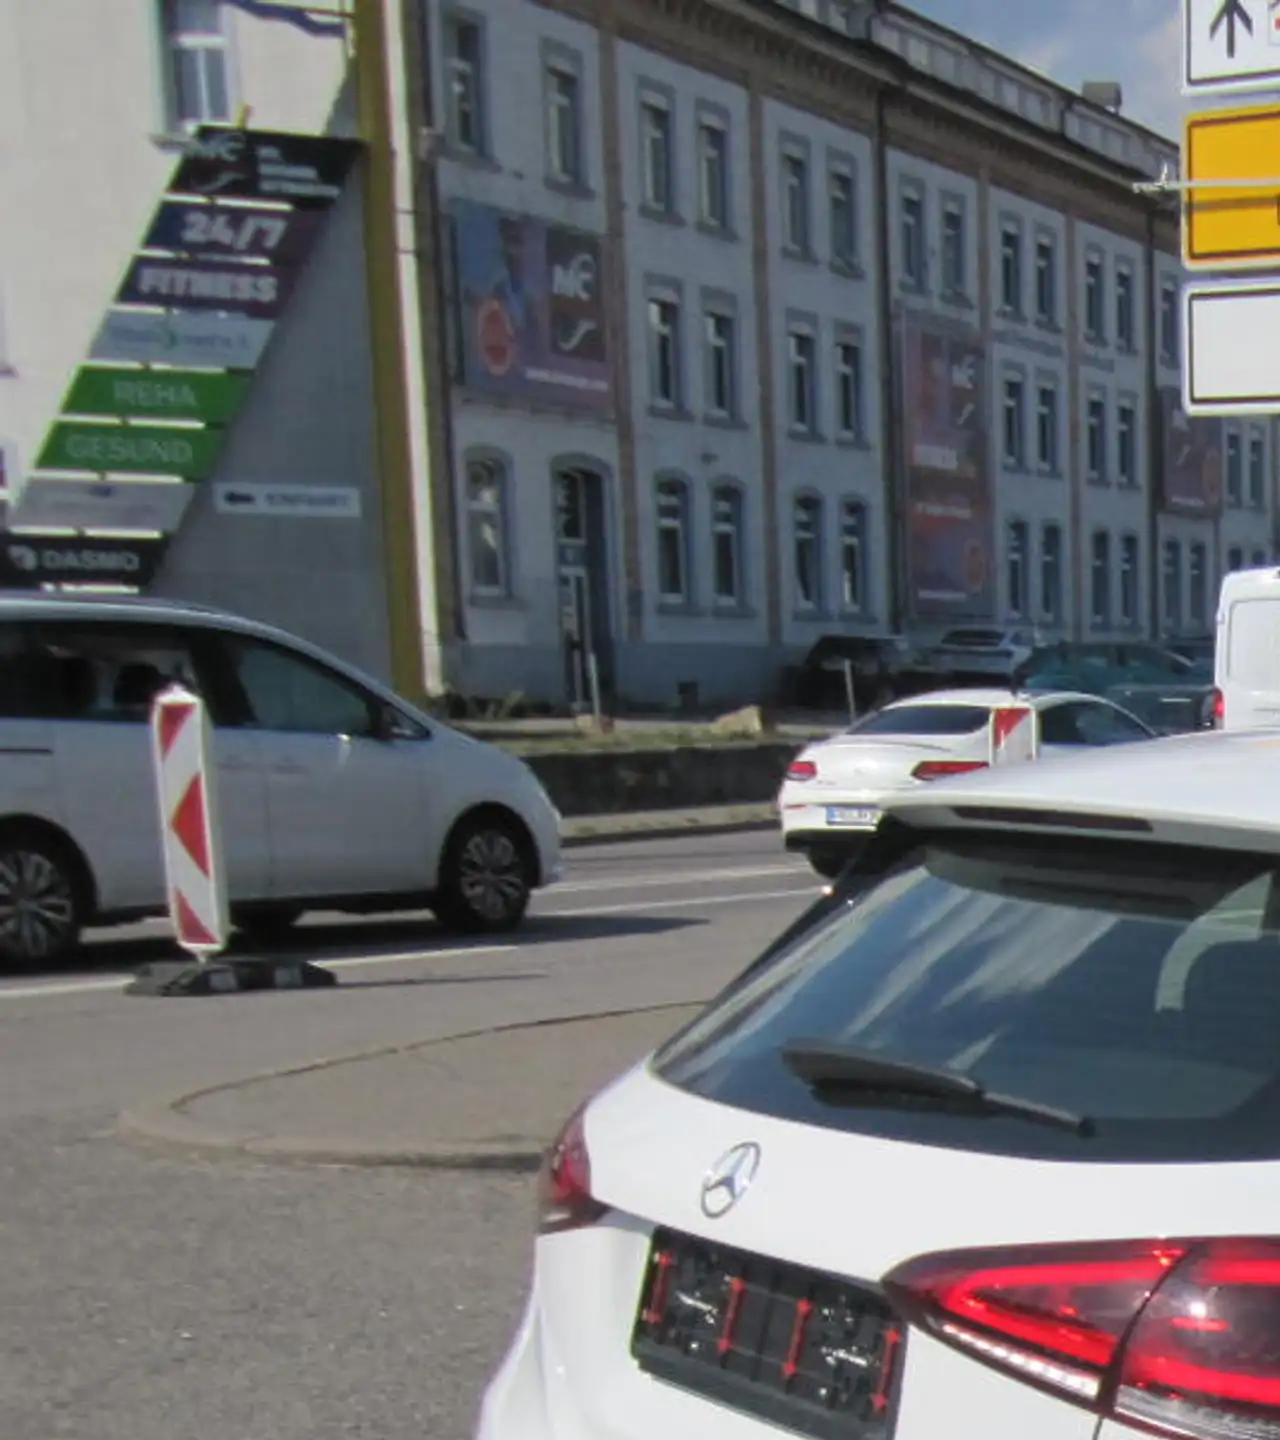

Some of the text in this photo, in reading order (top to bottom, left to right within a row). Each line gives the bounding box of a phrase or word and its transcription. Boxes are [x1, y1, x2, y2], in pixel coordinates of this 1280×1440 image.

[181, 211, 288, 250] 24/7
[137, 267, 279, 303] FITNESS
[113, 380, 197, 407] REHA
[65, 435, 194, 464] GESUND
